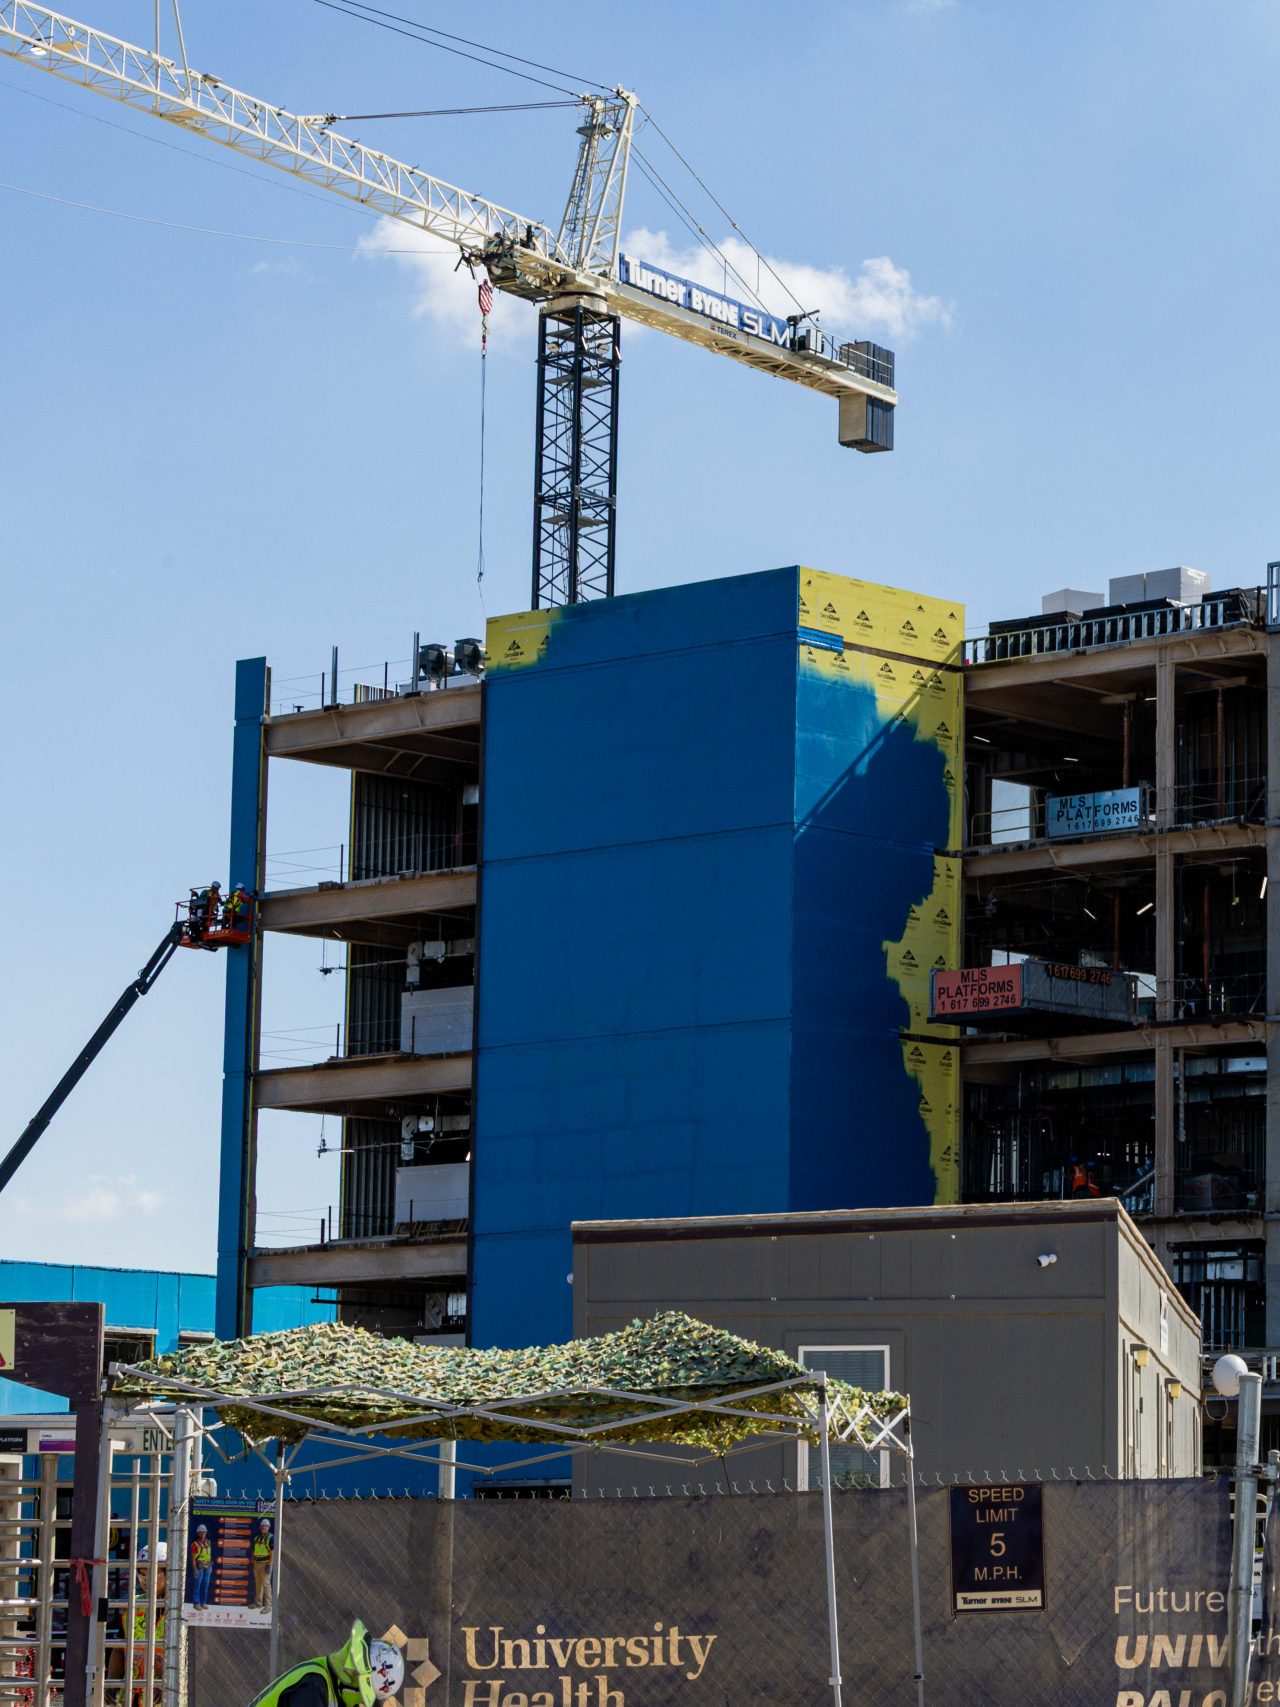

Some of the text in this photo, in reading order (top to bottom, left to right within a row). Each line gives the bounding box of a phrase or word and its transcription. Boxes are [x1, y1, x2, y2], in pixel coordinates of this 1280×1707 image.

[624, 253, 790, 348] Turner BYRNE SLM
[717, 325, 737, 340] TEREX
[1057, 801, 1138, 822] PLATFORMS
[1060, 796, 1086, 810] MLS
[961, 969, 988, 983] MLS
[938, 980, 1014, 999] PLATFORMS
[950, 997, 968, 1009] 617
[993, 994, 1016, 1006] 2746
[143, 1429, 175, 1451] ENTE
[968, 1488, 1025, 1503] SPEED
[976, 1508, 1018, 1523] LIMIT
[990, 1533, 1005, 1557] 5
[974, 1566, 1022, 1581] M.P.H.
[1114, 1586, 1225, 1614] Future
[461, 1621, 717, 1680] University
